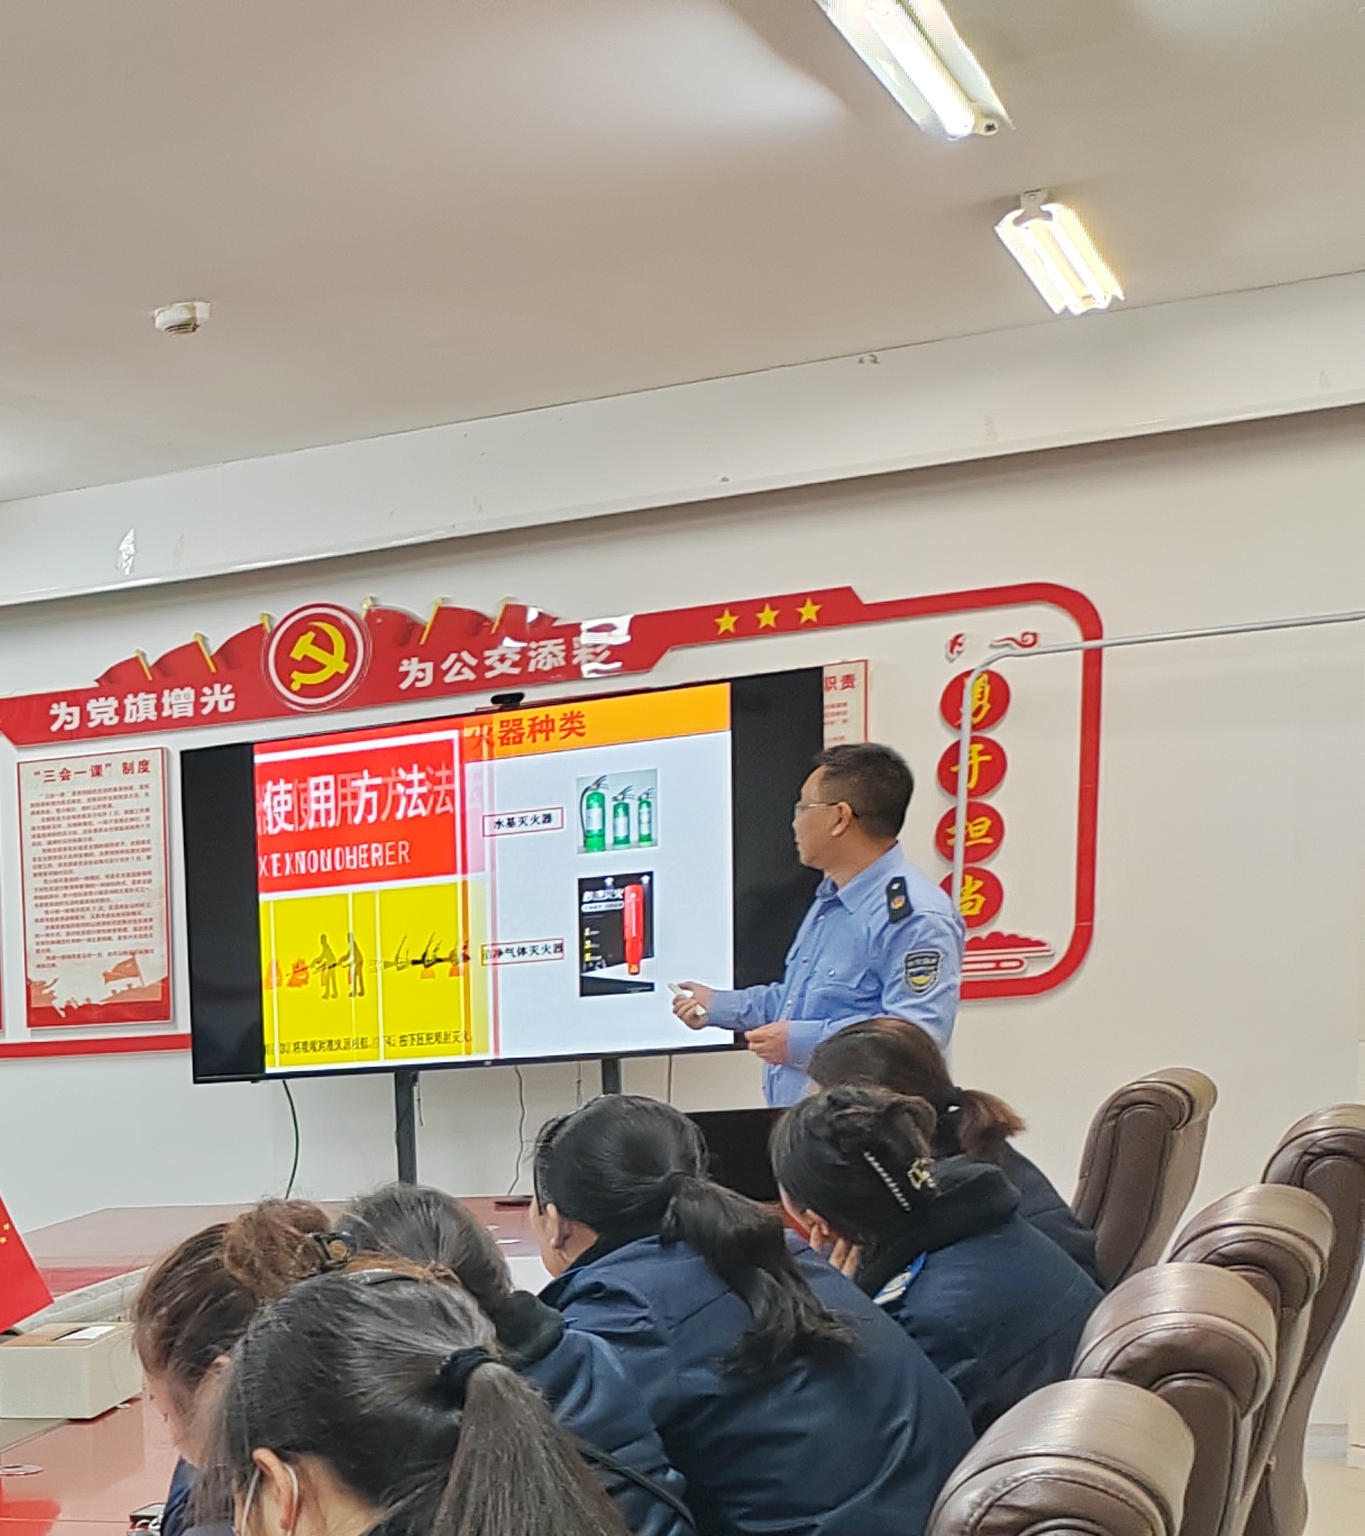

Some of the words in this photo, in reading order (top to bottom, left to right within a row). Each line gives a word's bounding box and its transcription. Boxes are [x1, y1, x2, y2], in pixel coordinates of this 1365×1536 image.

[48, 683, 237, 733] 为党旗增光
[398, 639, 612, 690] 为公交添彩
[493, 812, 553, 831] 水基灭火器
